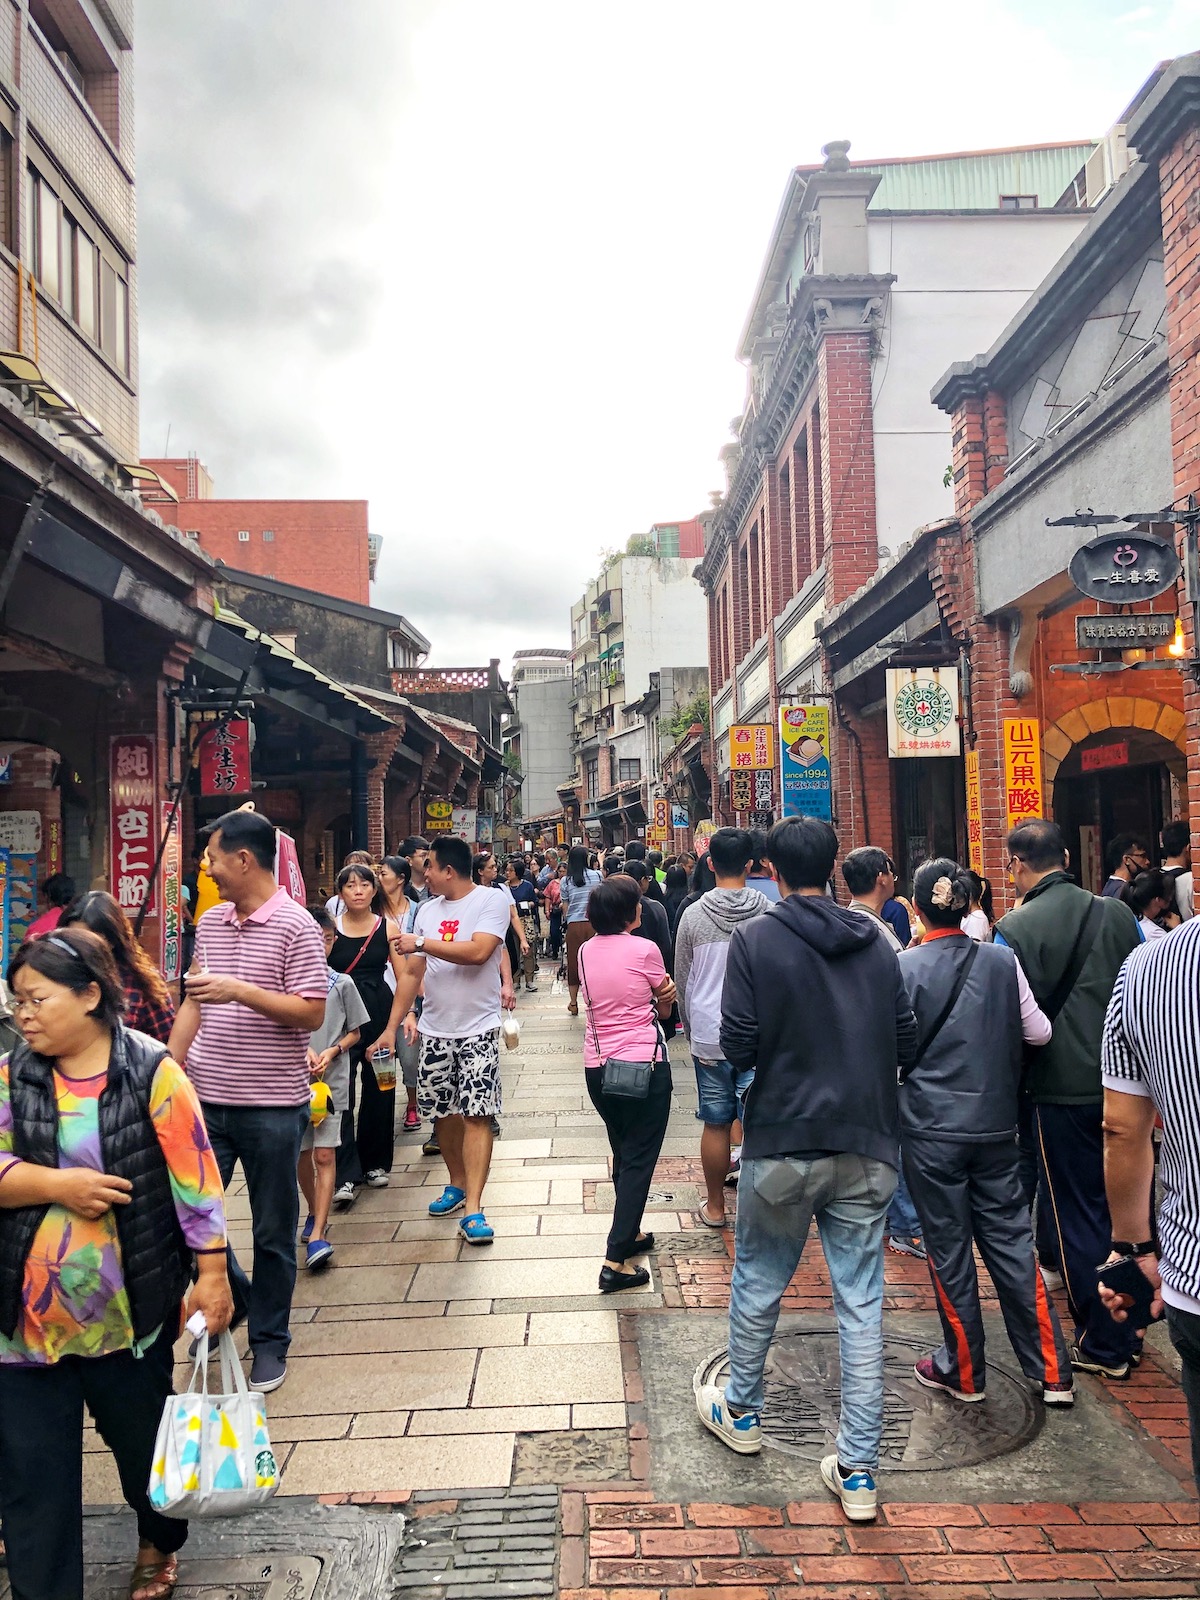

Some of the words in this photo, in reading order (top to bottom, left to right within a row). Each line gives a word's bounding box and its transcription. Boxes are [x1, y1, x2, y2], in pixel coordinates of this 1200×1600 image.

[895, 681, 919, 735] PATISSERIE
[928, 682, 951, 726] CHANNEL
[735, 729, 752, 766] 春捲
[755, 728, 768, 766] 花生冰淇淋
[898, 740, 951, 750] 五號烘焙坊
[674, 811, 688, 824] 冰
[711, 1402, 723, 1425] N
